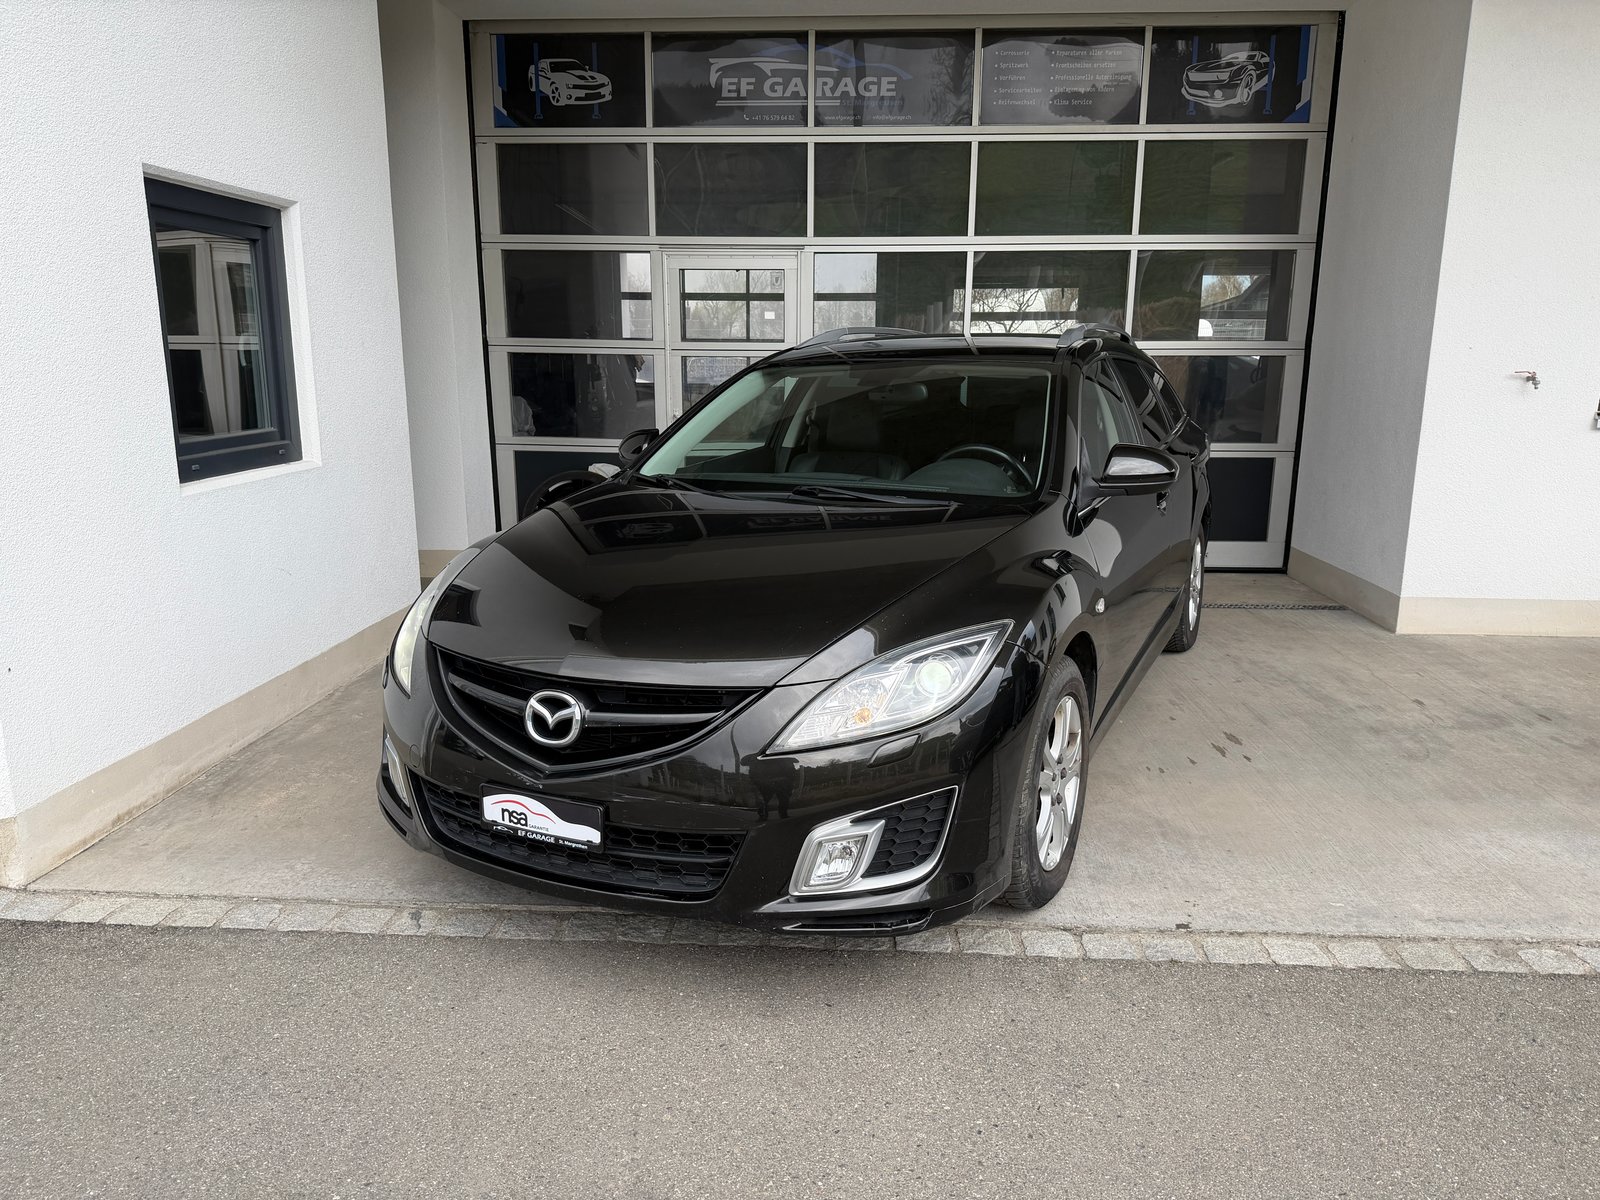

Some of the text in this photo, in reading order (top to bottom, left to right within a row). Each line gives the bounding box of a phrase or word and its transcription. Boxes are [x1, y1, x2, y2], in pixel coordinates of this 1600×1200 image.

[721, 76, 898, 98] EF GARAGE
[501, 807, 528, 827] nsa
[518, 829, 526, 837] EF
[526, 832, 555, 843] GARAGE
